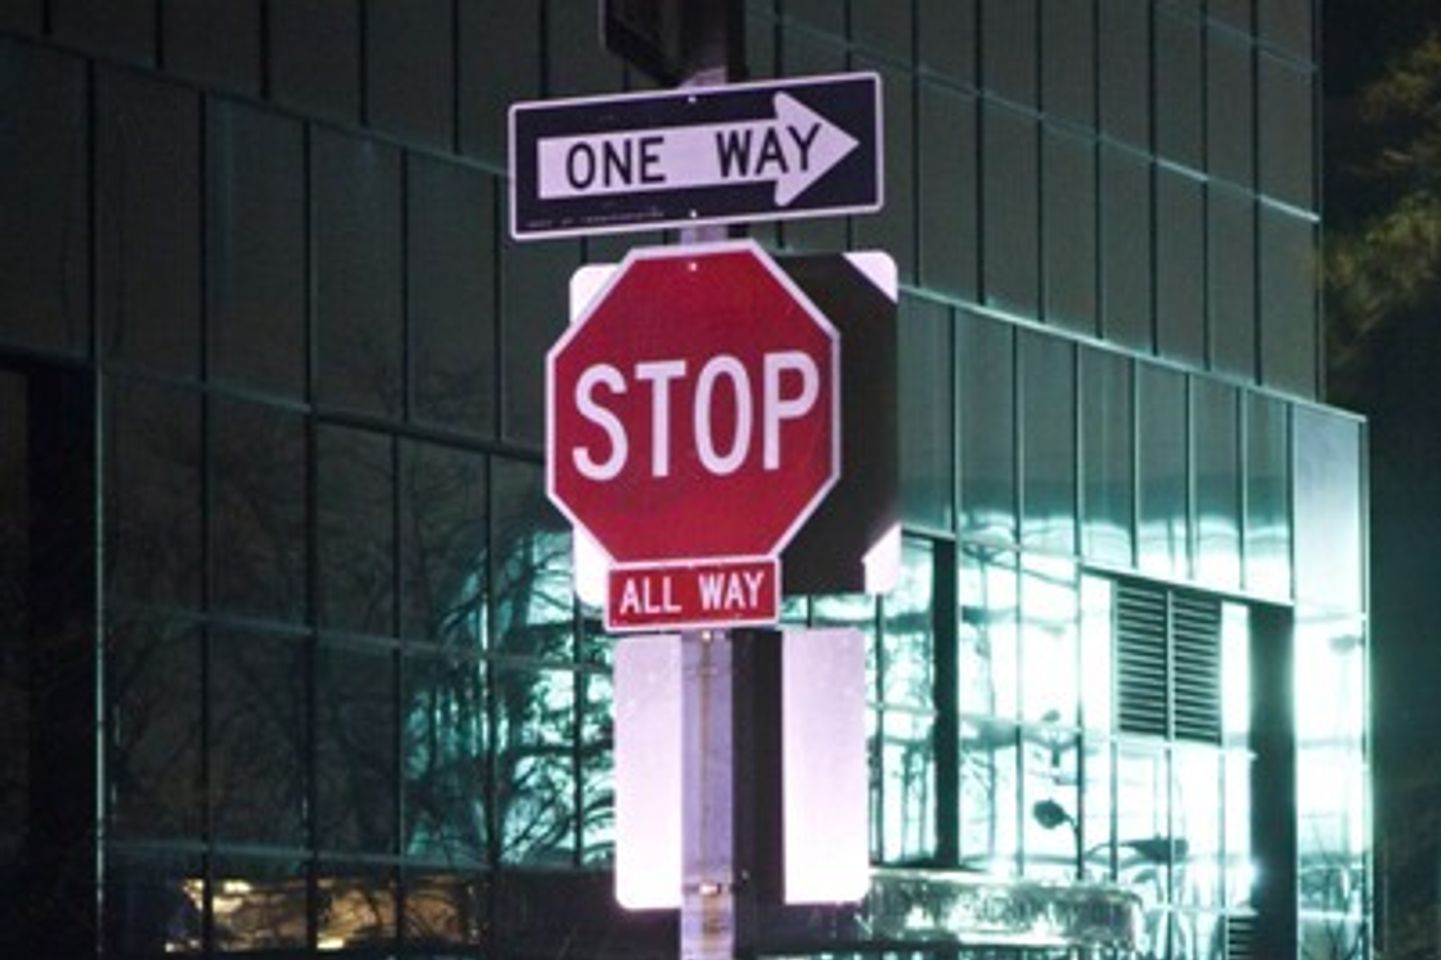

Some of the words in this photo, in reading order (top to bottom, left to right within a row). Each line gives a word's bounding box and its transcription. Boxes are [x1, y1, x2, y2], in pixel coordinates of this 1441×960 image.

[565, 136, 667, 191] ONE
[714, 121, 822, 179] WAY
[572, 350, 821, 481] STOP
[618, 576, 682, 615] ALL
[698, 571, 765, 610] WAY
